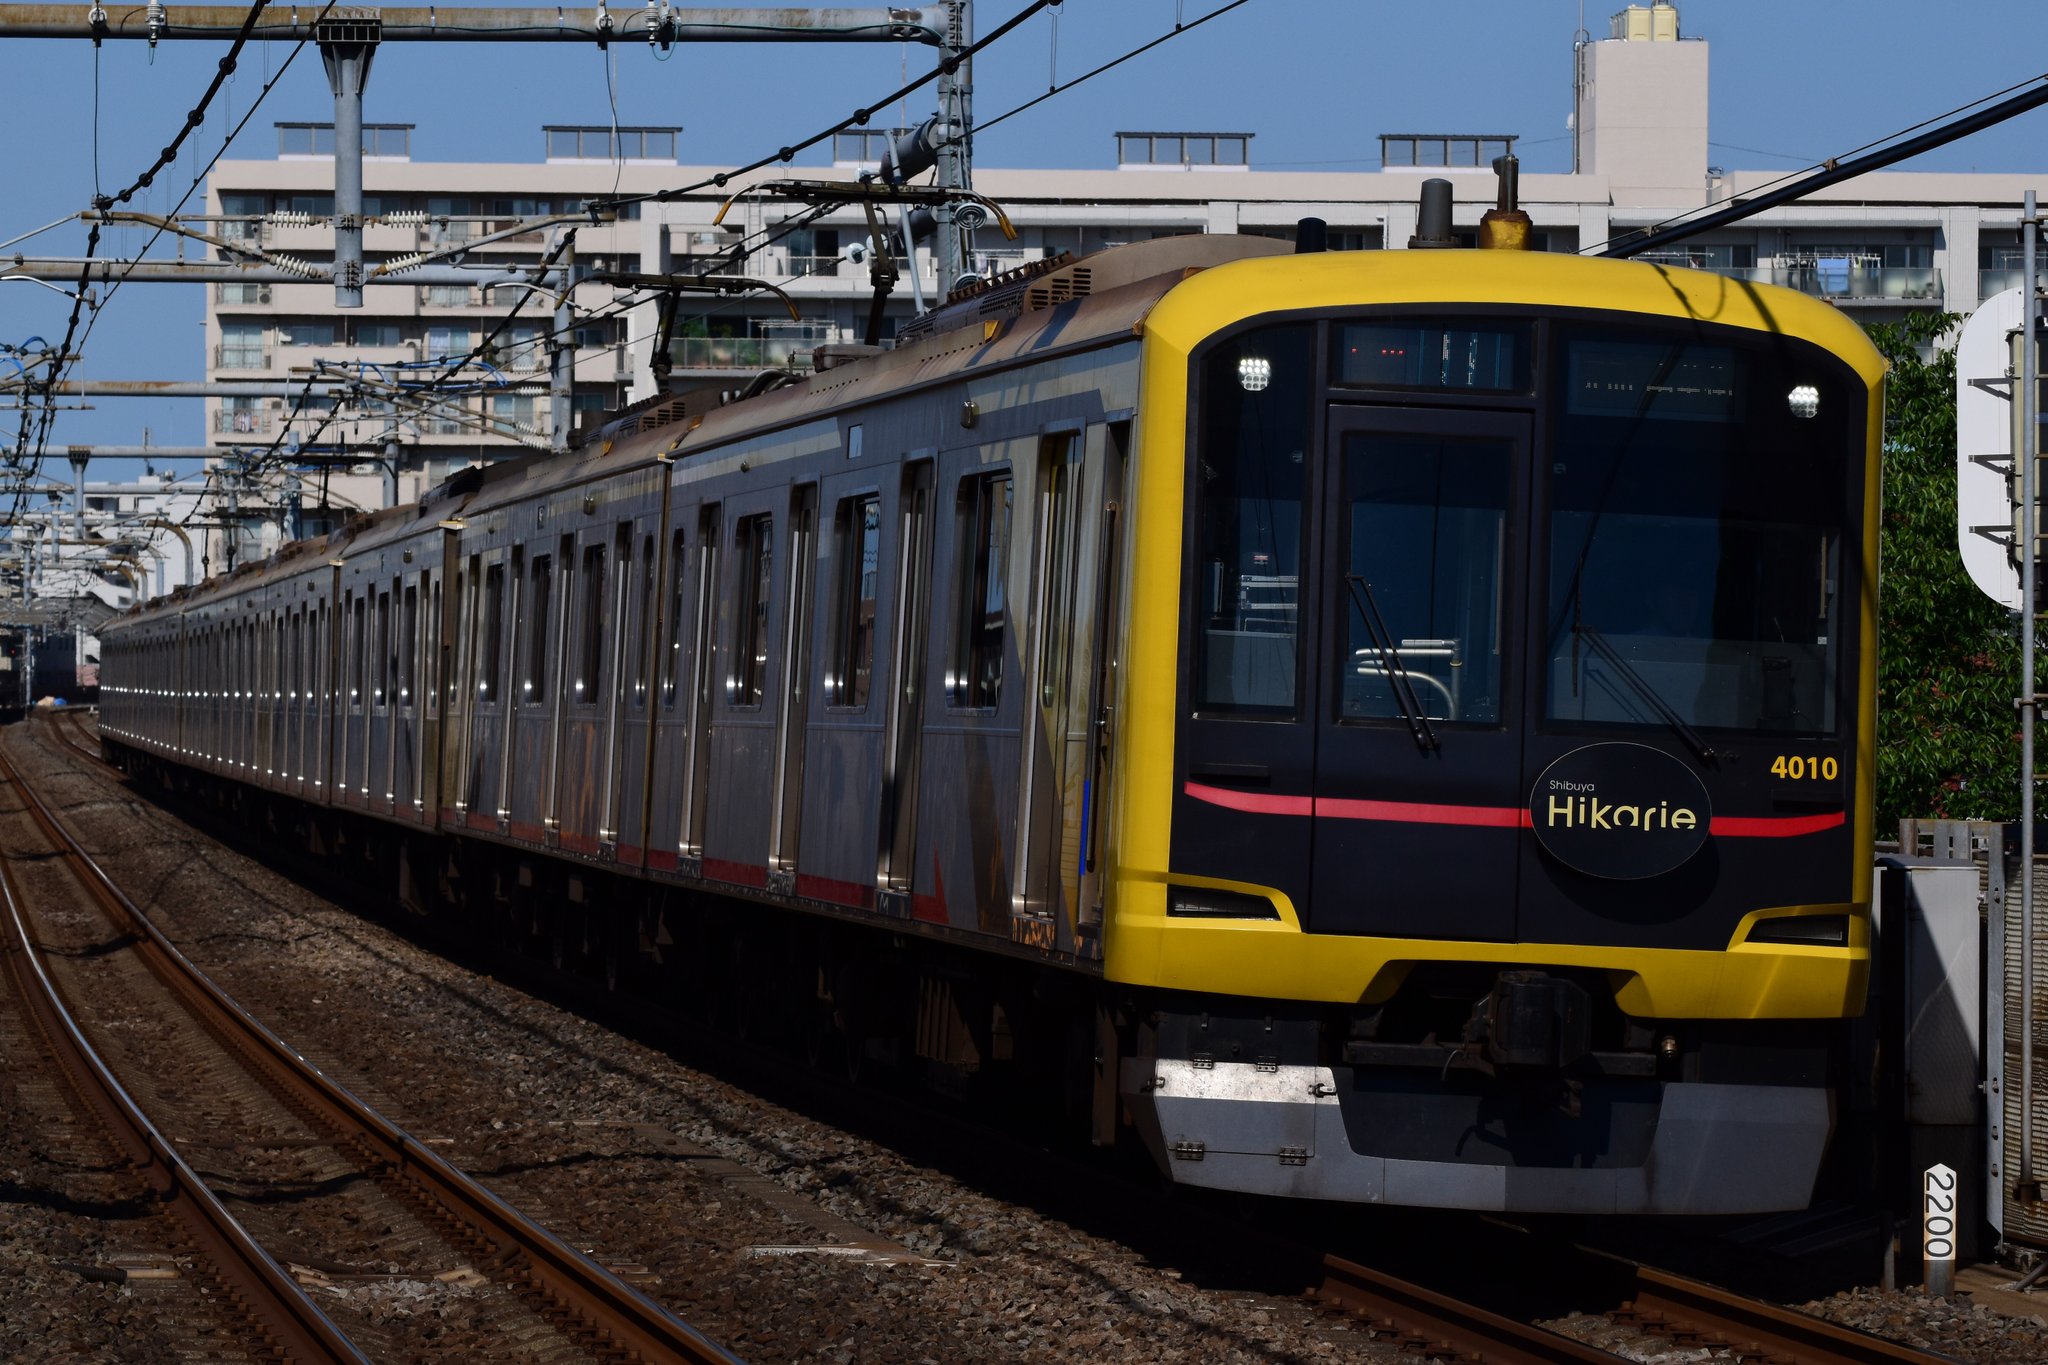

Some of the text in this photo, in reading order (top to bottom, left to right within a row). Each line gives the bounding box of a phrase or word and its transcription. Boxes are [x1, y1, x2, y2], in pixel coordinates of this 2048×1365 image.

[1771, 756, 1838, 780] 4010
[1549, 780, 1595, 793] Shibuya
[1548, 795, 1697, 831] Hikarie
[1925, 1171, 1955, 1258] 2200
